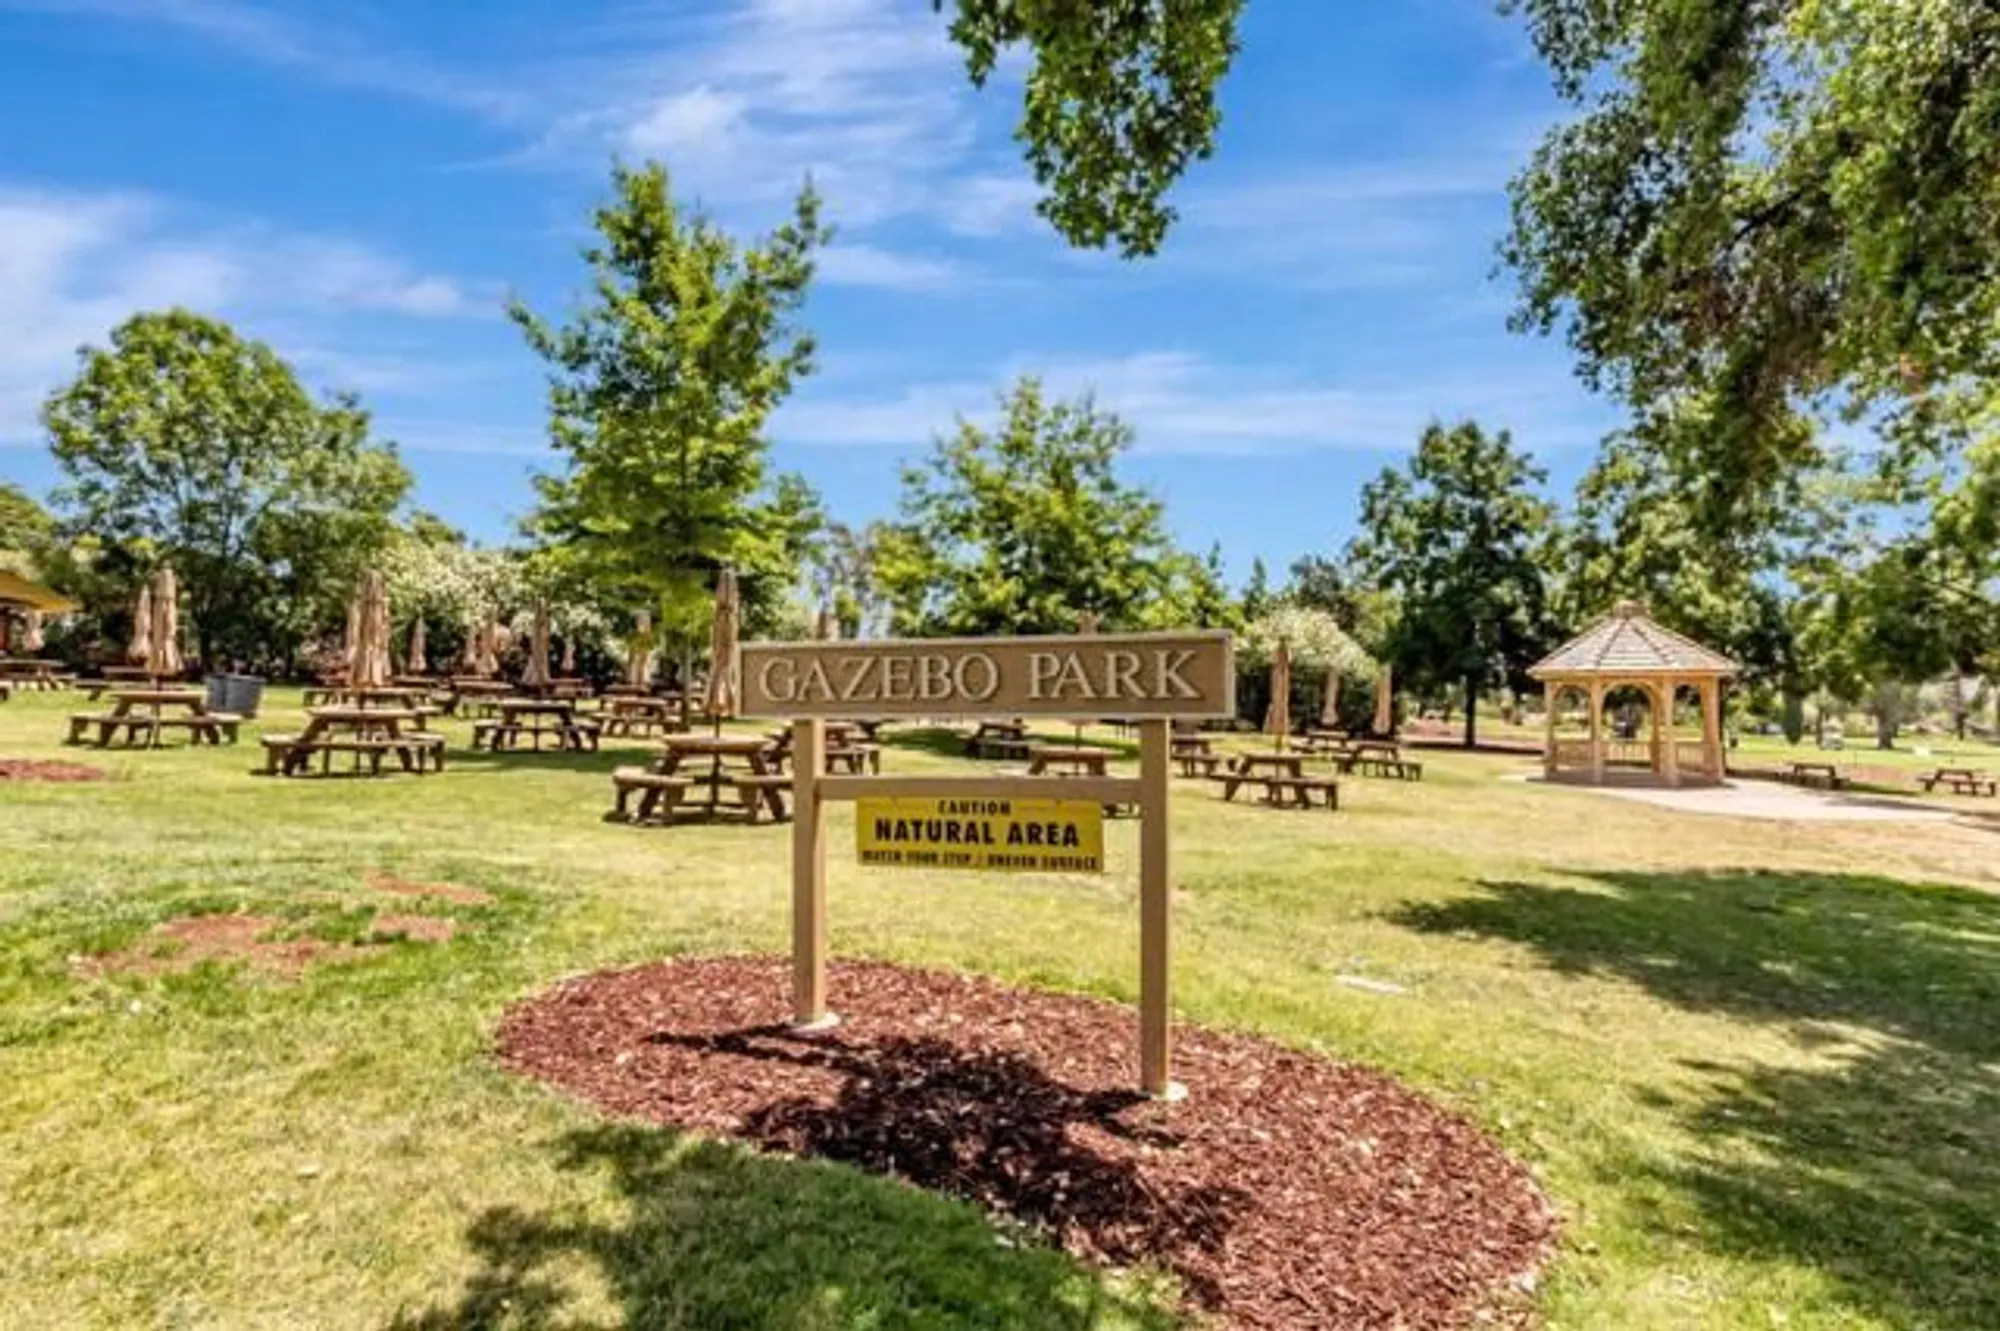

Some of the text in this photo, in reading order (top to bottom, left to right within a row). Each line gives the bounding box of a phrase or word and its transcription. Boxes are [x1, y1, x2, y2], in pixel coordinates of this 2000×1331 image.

[758, 649, 1197, 702] GAZEBO PARK
[938, 799, 1011, 816] CAUTION
[875, 817, 1080, 848] NATURAL AREA
